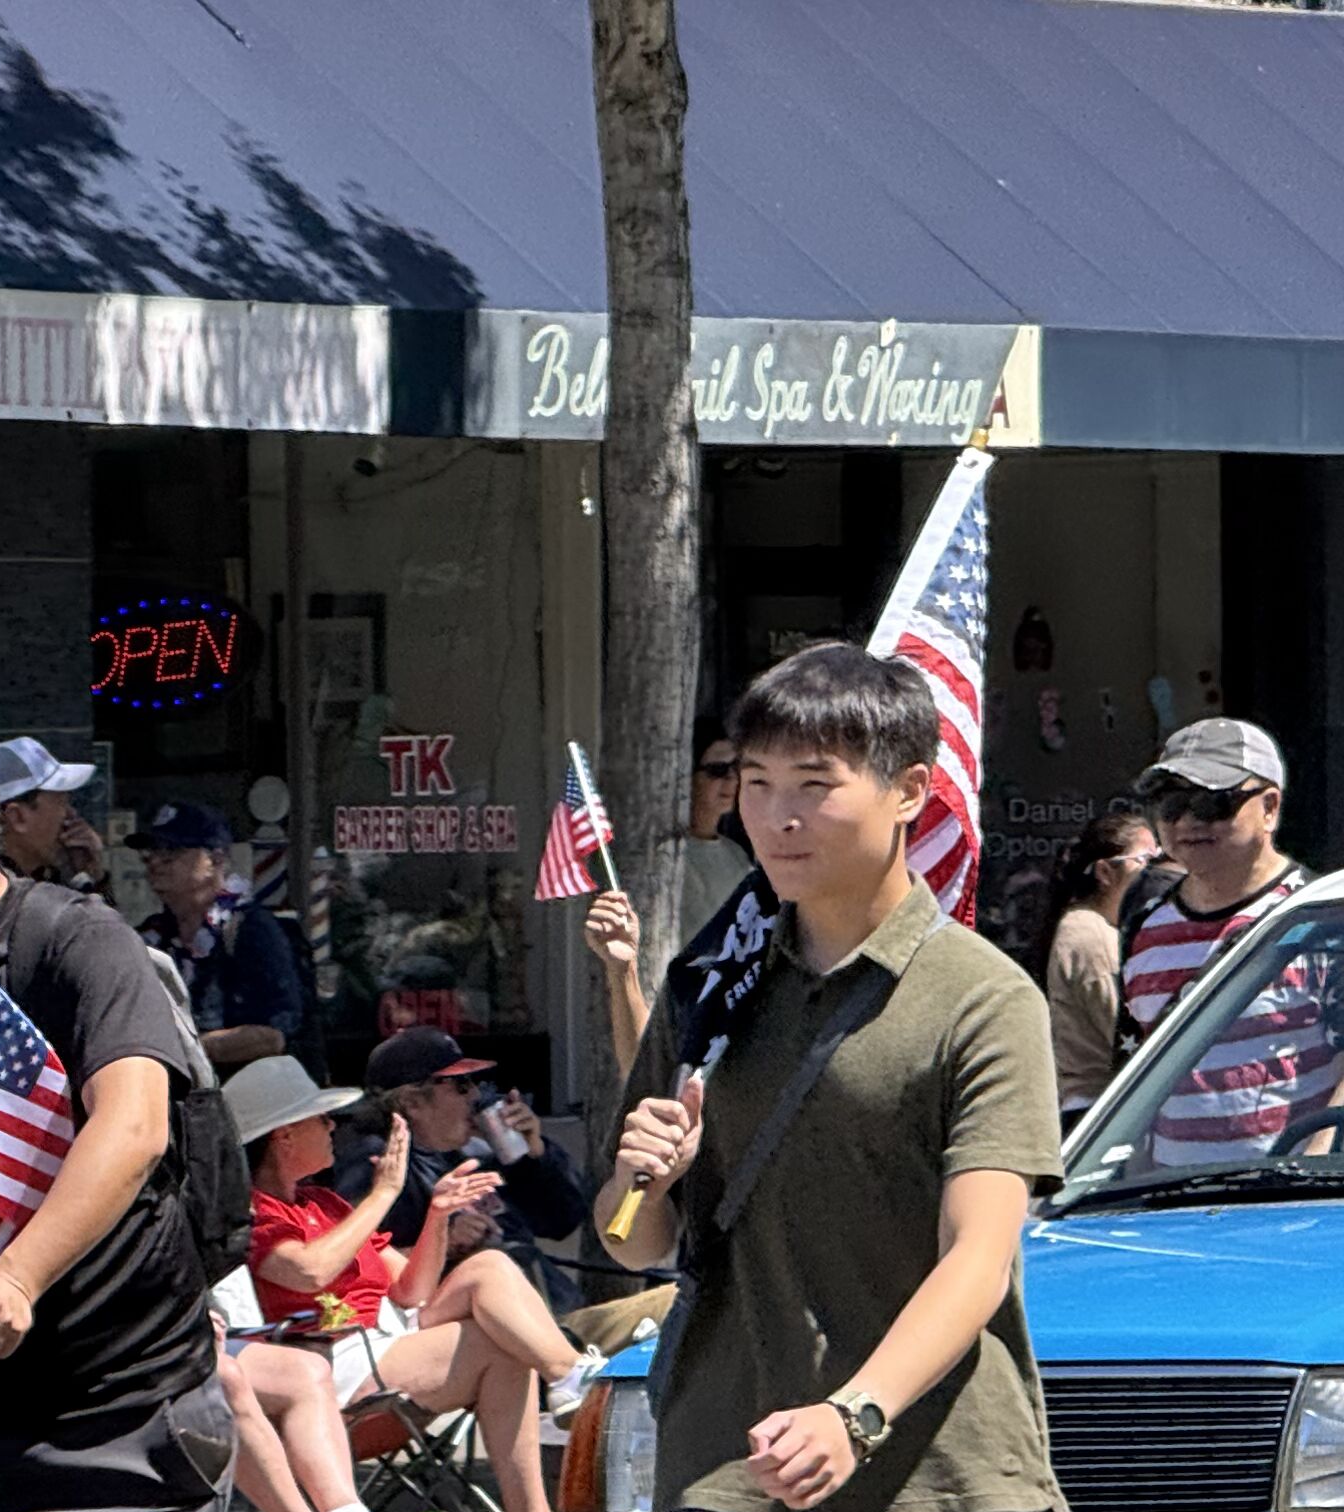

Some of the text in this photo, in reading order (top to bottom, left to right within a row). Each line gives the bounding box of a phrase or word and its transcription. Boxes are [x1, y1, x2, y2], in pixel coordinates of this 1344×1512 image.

[744, 342, 812, 439] Spa
[822, 334, 856, 423] &
[857, 341, 984, 446] Waxing
[89, 613, 238, 690] OPEN
[379, 734, 457, 797] TK
[334, 804, 518, 852] BARBER SHOP & SPA
[1009, 798, 1095, 823] Daniel
